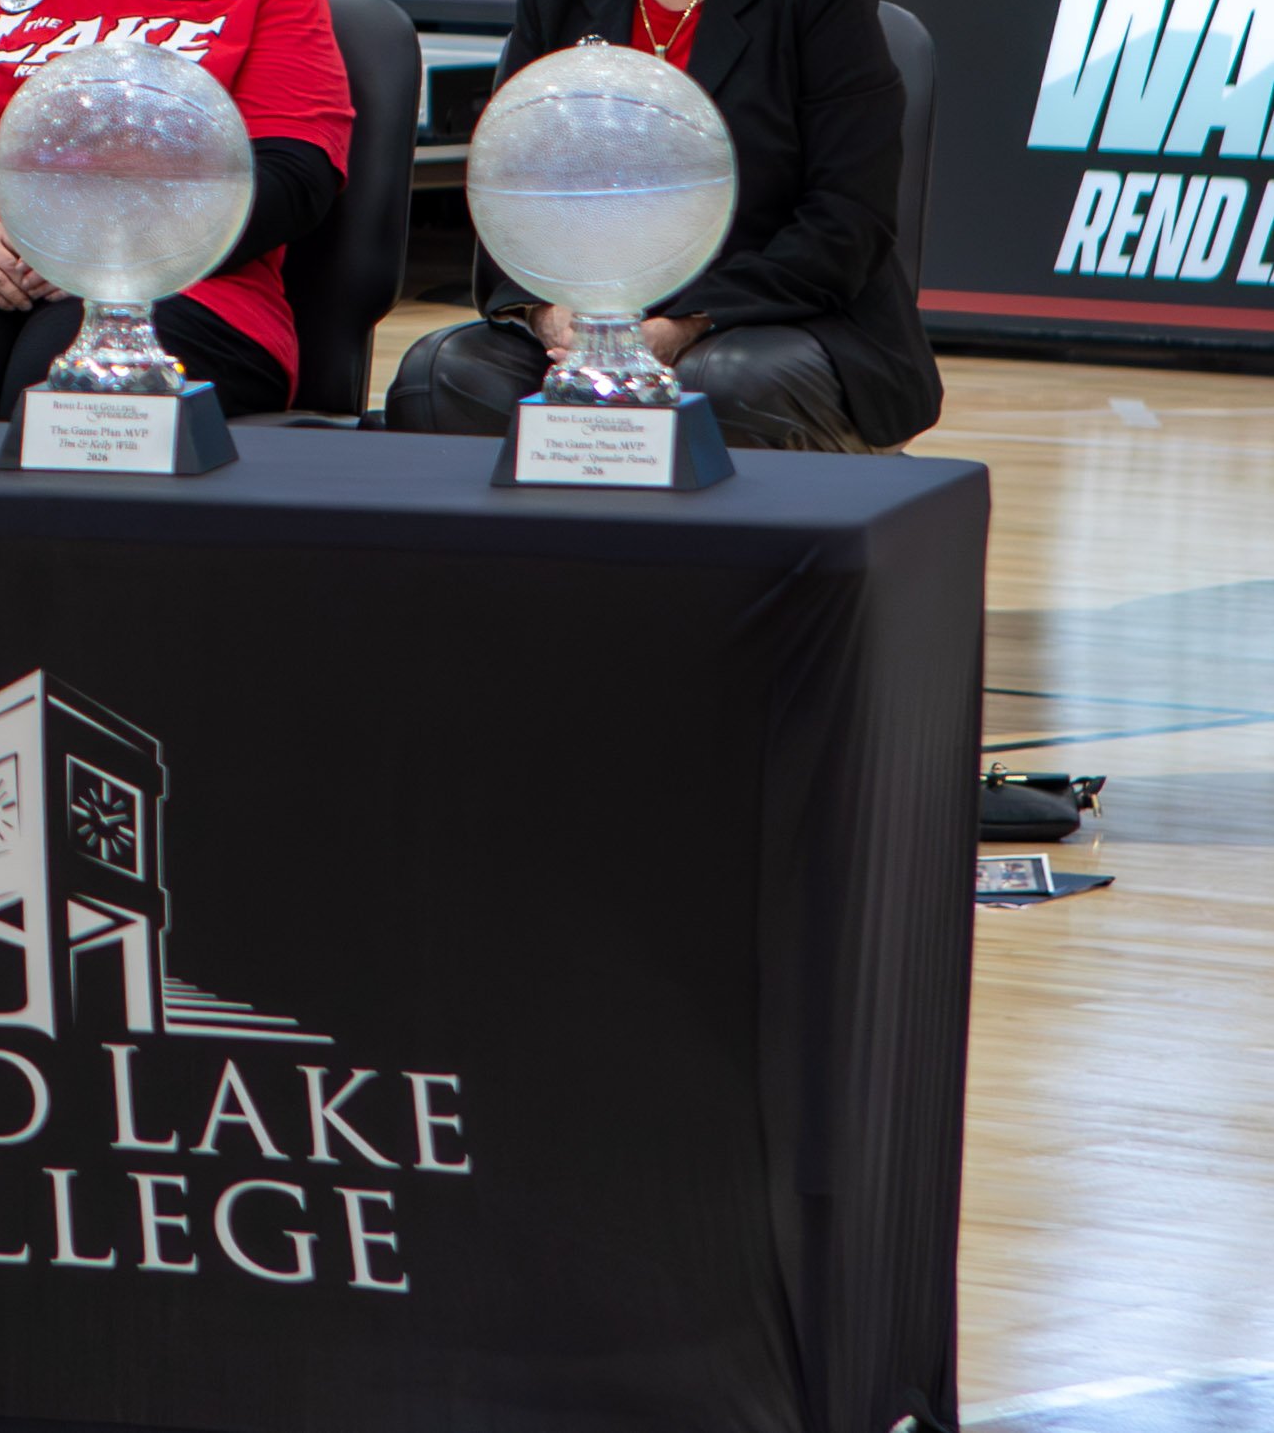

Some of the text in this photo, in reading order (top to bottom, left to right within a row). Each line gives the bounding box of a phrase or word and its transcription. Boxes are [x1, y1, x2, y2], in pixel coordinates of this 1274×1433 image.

[23, 17, 63, 33] THE
[1053, 169, 1250, 283] REND
[50, 425, 149, 438] The Game Plan MVP
[544, 438, 647, 451] The Game Plan MVP
[100, 1041, 473, 1175] LAKE
